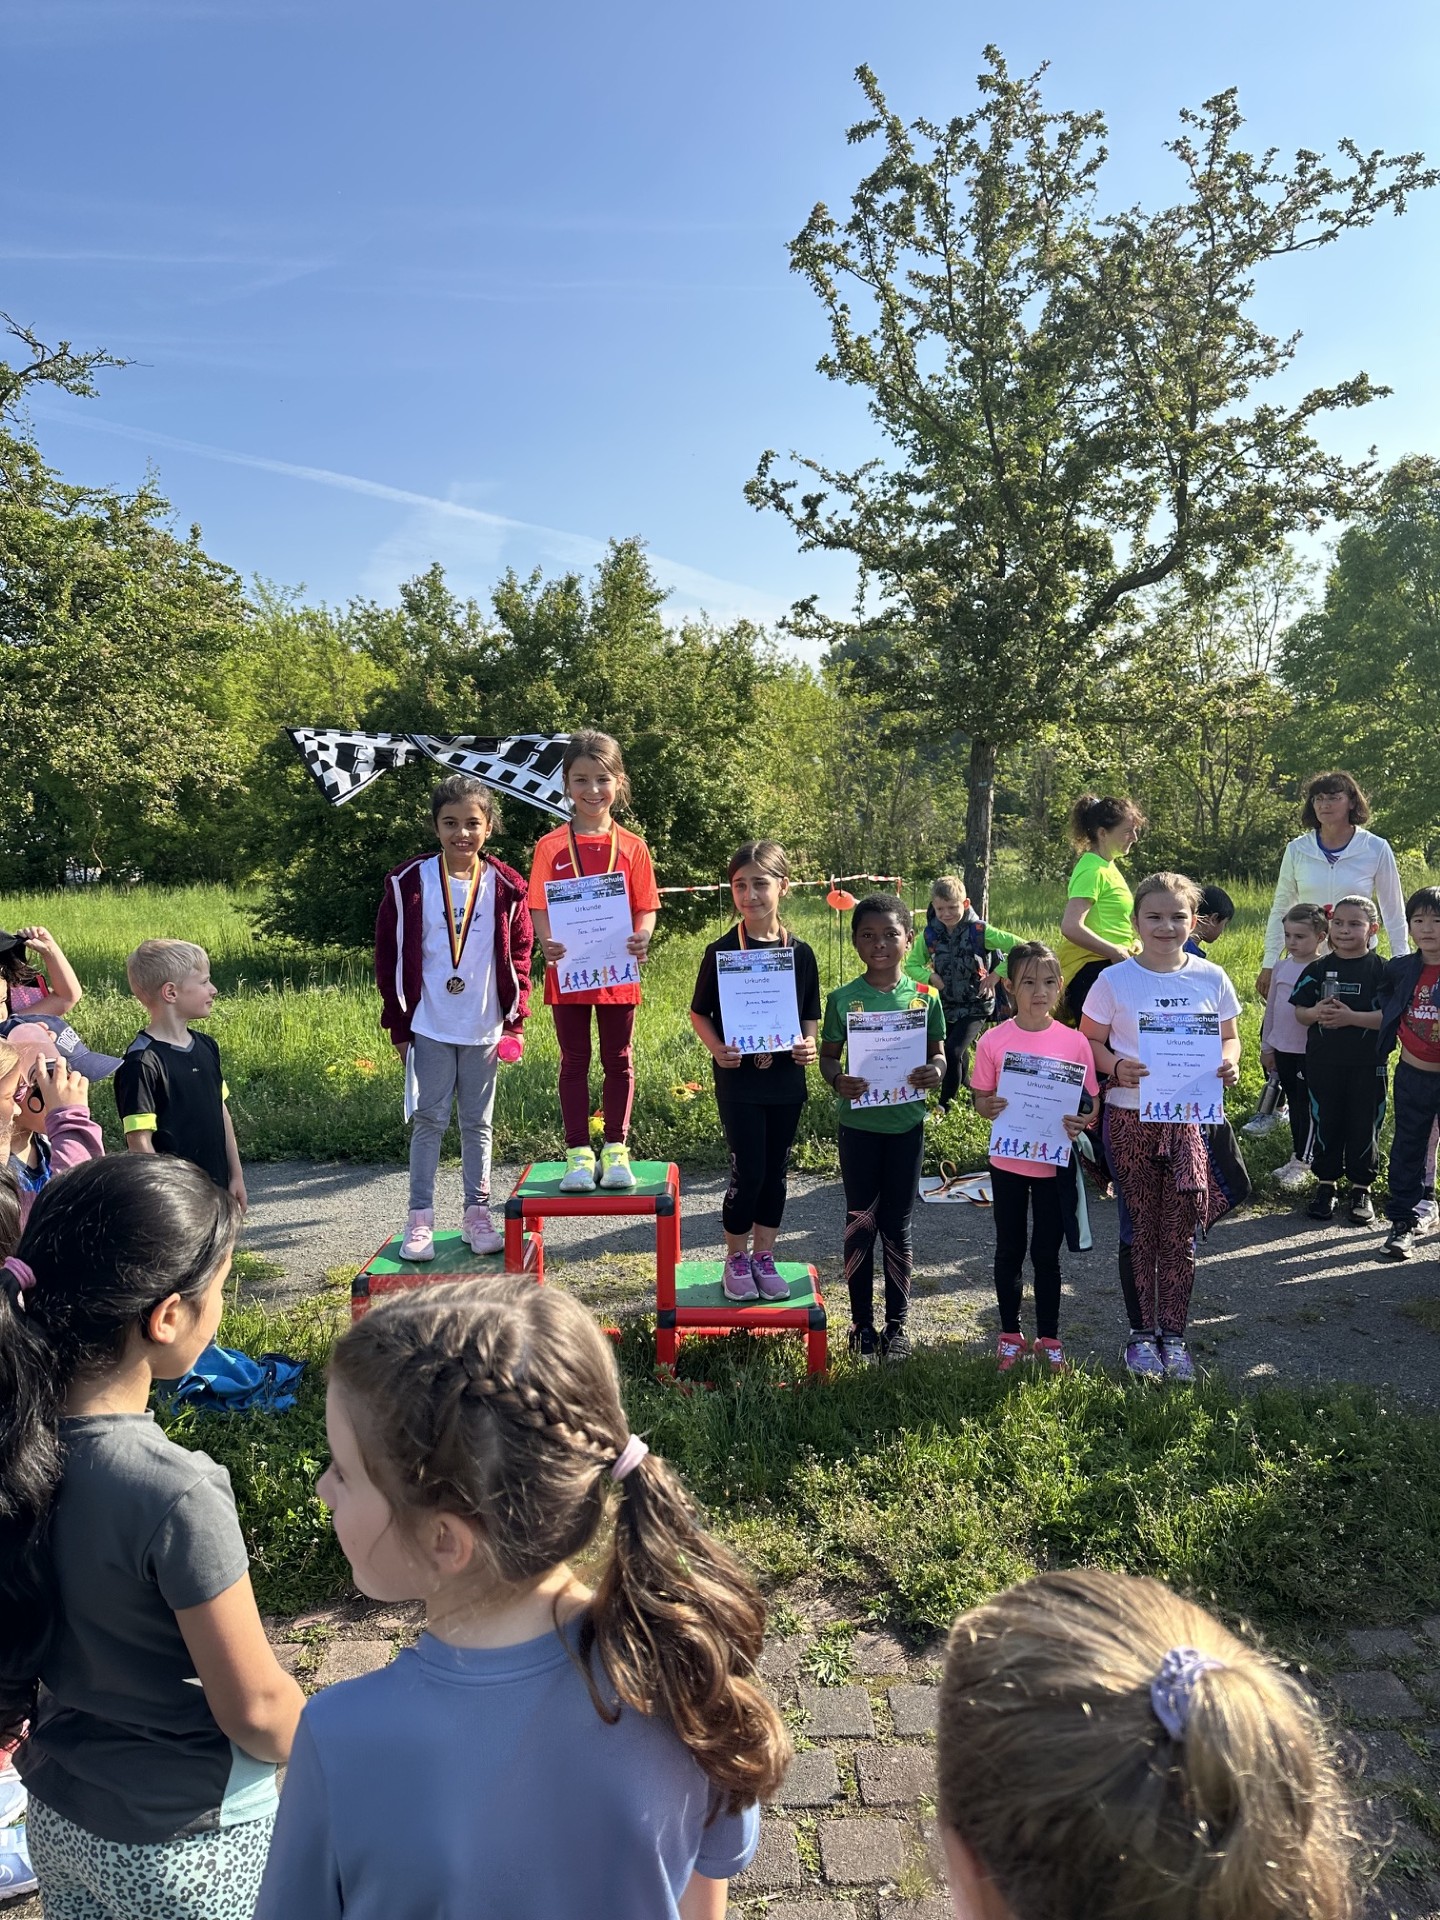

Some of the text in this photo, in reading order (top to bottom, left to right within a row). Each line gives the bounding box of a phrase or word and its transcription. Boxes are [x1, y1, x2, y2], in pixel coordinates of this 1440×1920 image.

[577, 875, 624, 889] Grundschule
[575, 904, 602, 913] Urkunde
[748, 951, 793, 960] Grundschule
[880, 1011, 925, 1021] Grundschule
[1171, 1014, 1218, 1022] Grundschule
[1413, 1011, 1439, 1020] WAR
[1037, 1058, 1085, 1074] Grundschule
[1027, 1080, 1055, 1090] Urkunde
